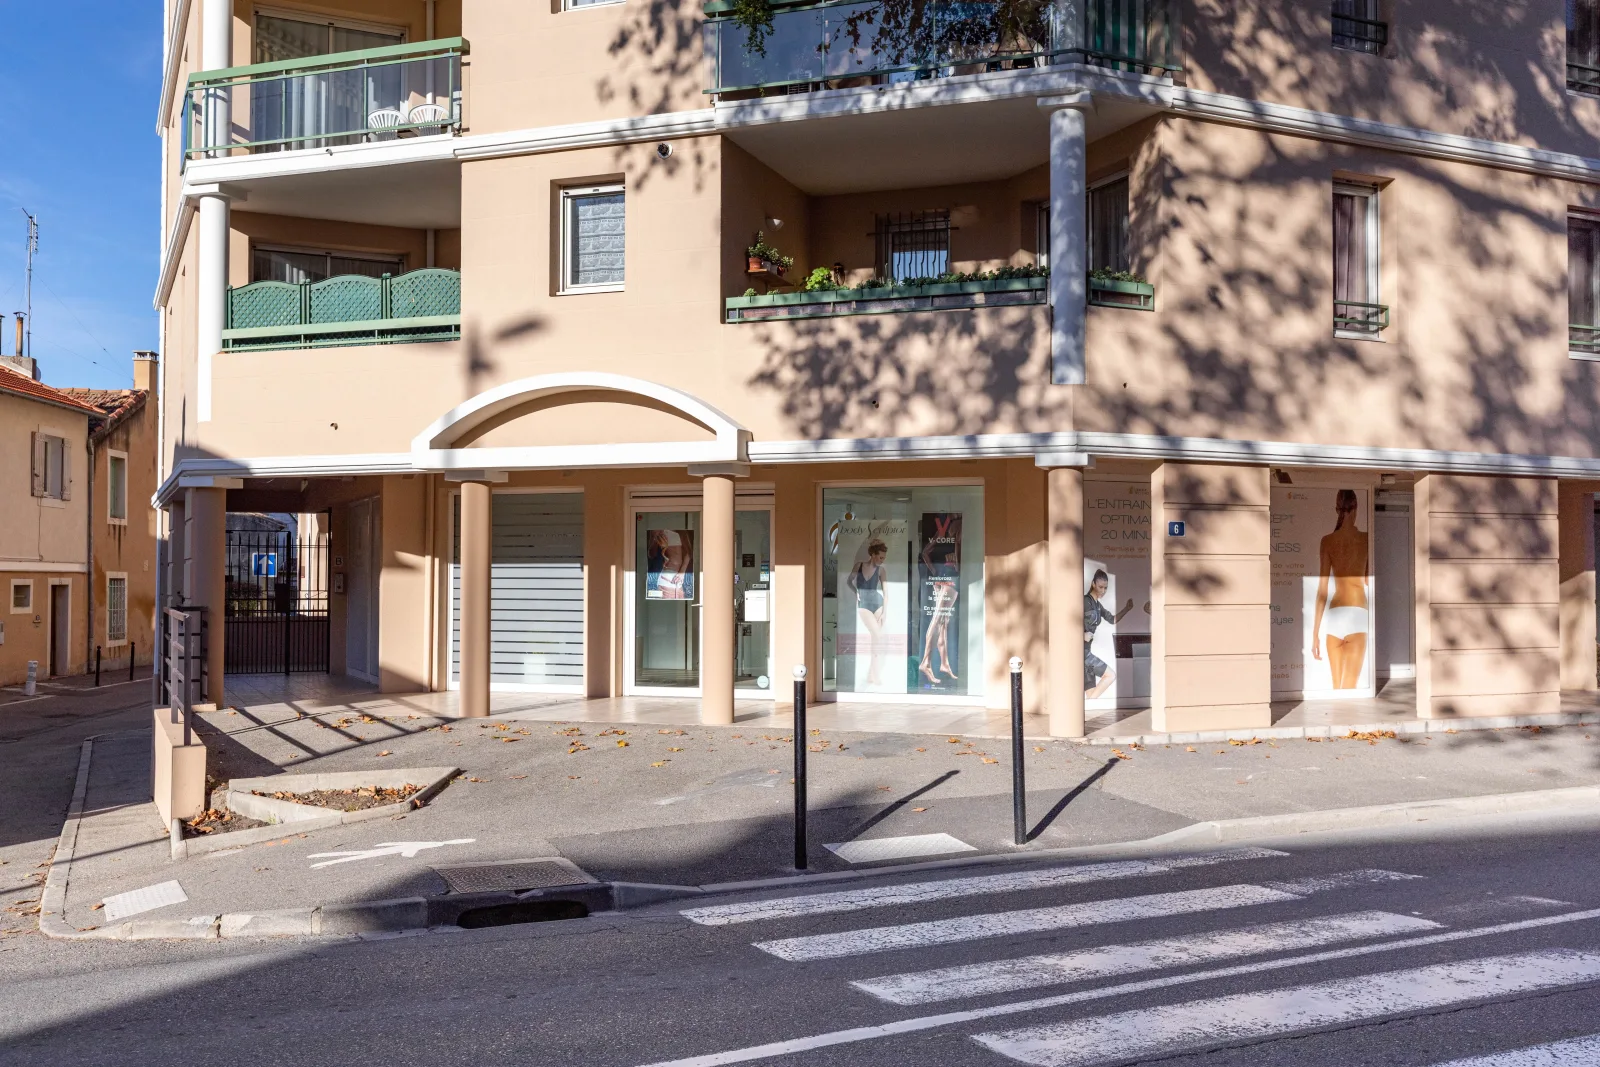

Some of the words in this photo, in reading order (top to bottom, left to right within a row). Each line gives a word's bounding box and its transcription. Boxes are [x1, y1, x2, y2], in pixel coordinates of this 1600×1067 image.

[1174, 524, 1179, 534] 6
[1101, 529, 1118, 540] 20
[336, 557, 342, 565] B
